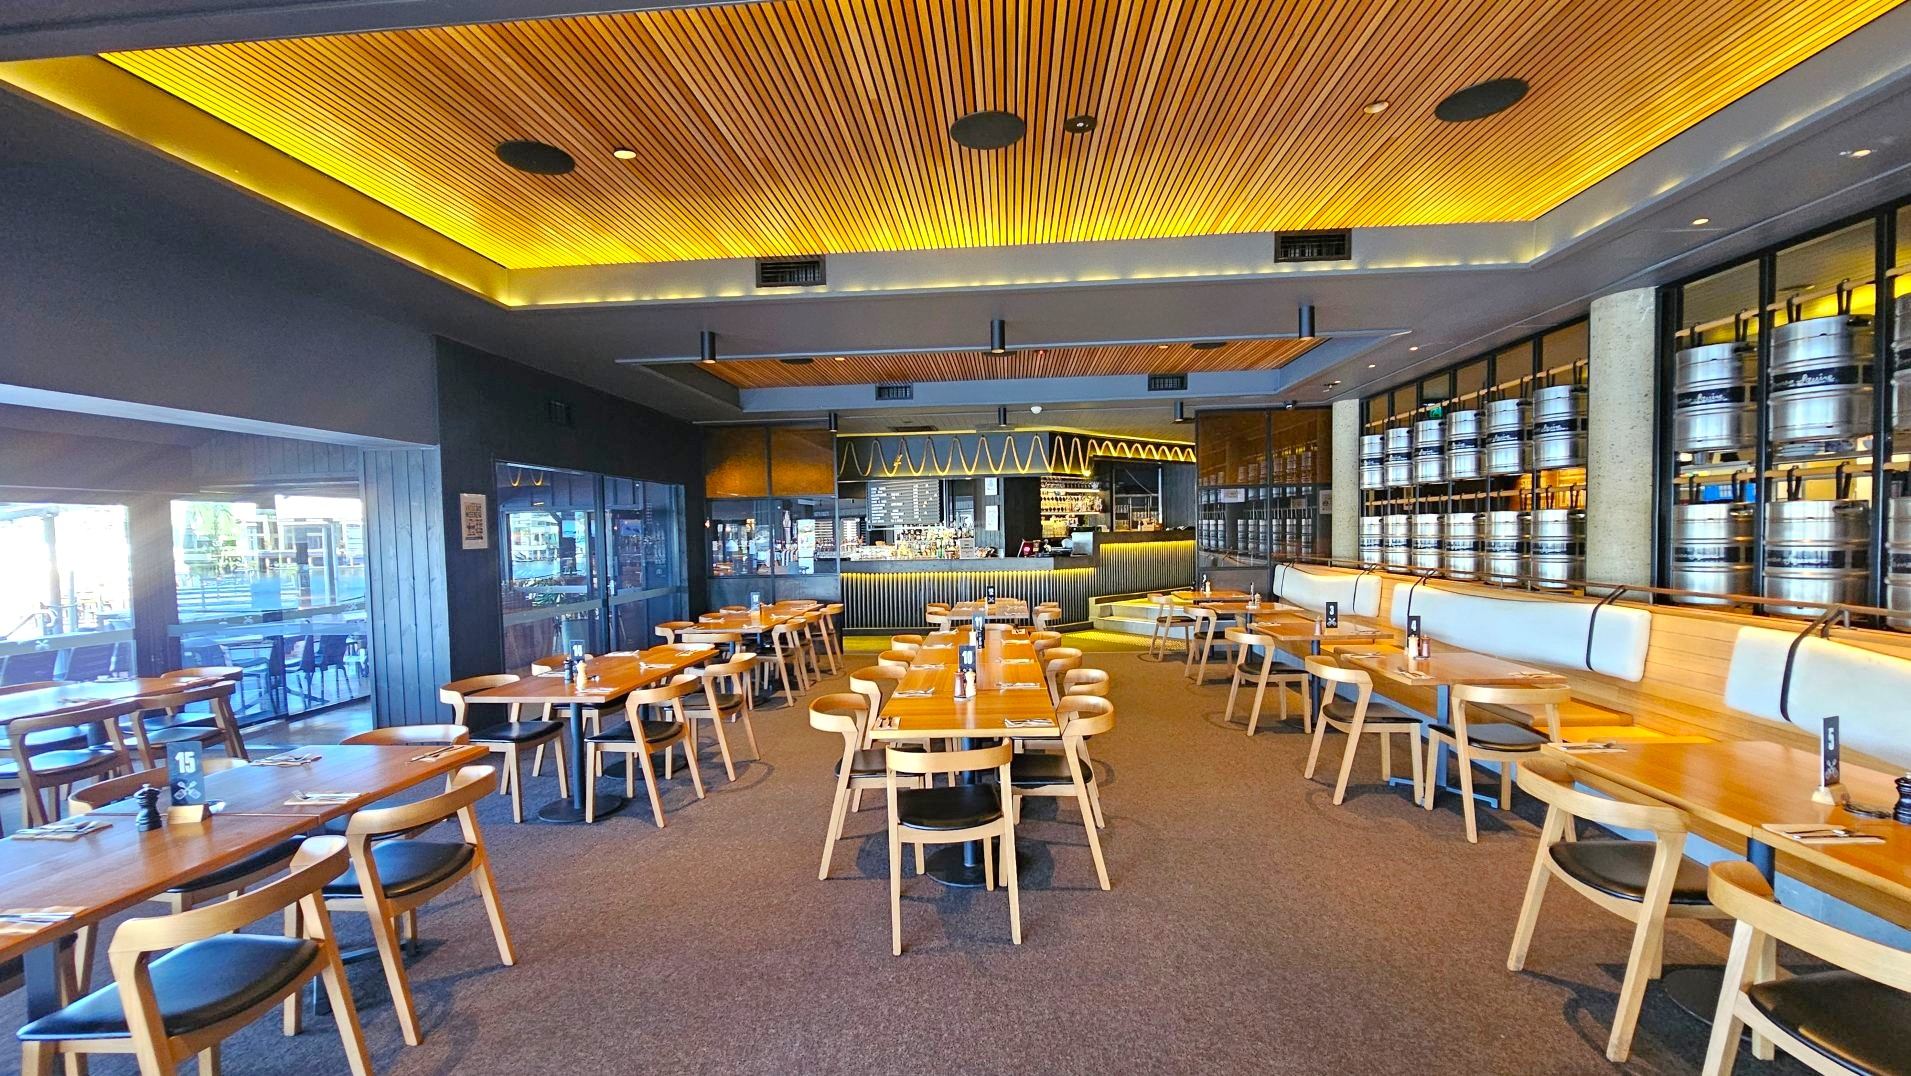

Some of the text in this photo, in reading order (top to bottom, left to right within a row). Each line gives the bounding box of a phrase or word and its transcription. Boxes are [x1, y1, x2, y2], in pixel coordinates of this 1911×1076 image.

[1329, 605, 1335, 616] 3
[1411, 620, 1417, 632] 4
[962, 651, 973, 665] 10
[1828, 727, 1835, 751] 5
[174, 751, 196, 774] 15
